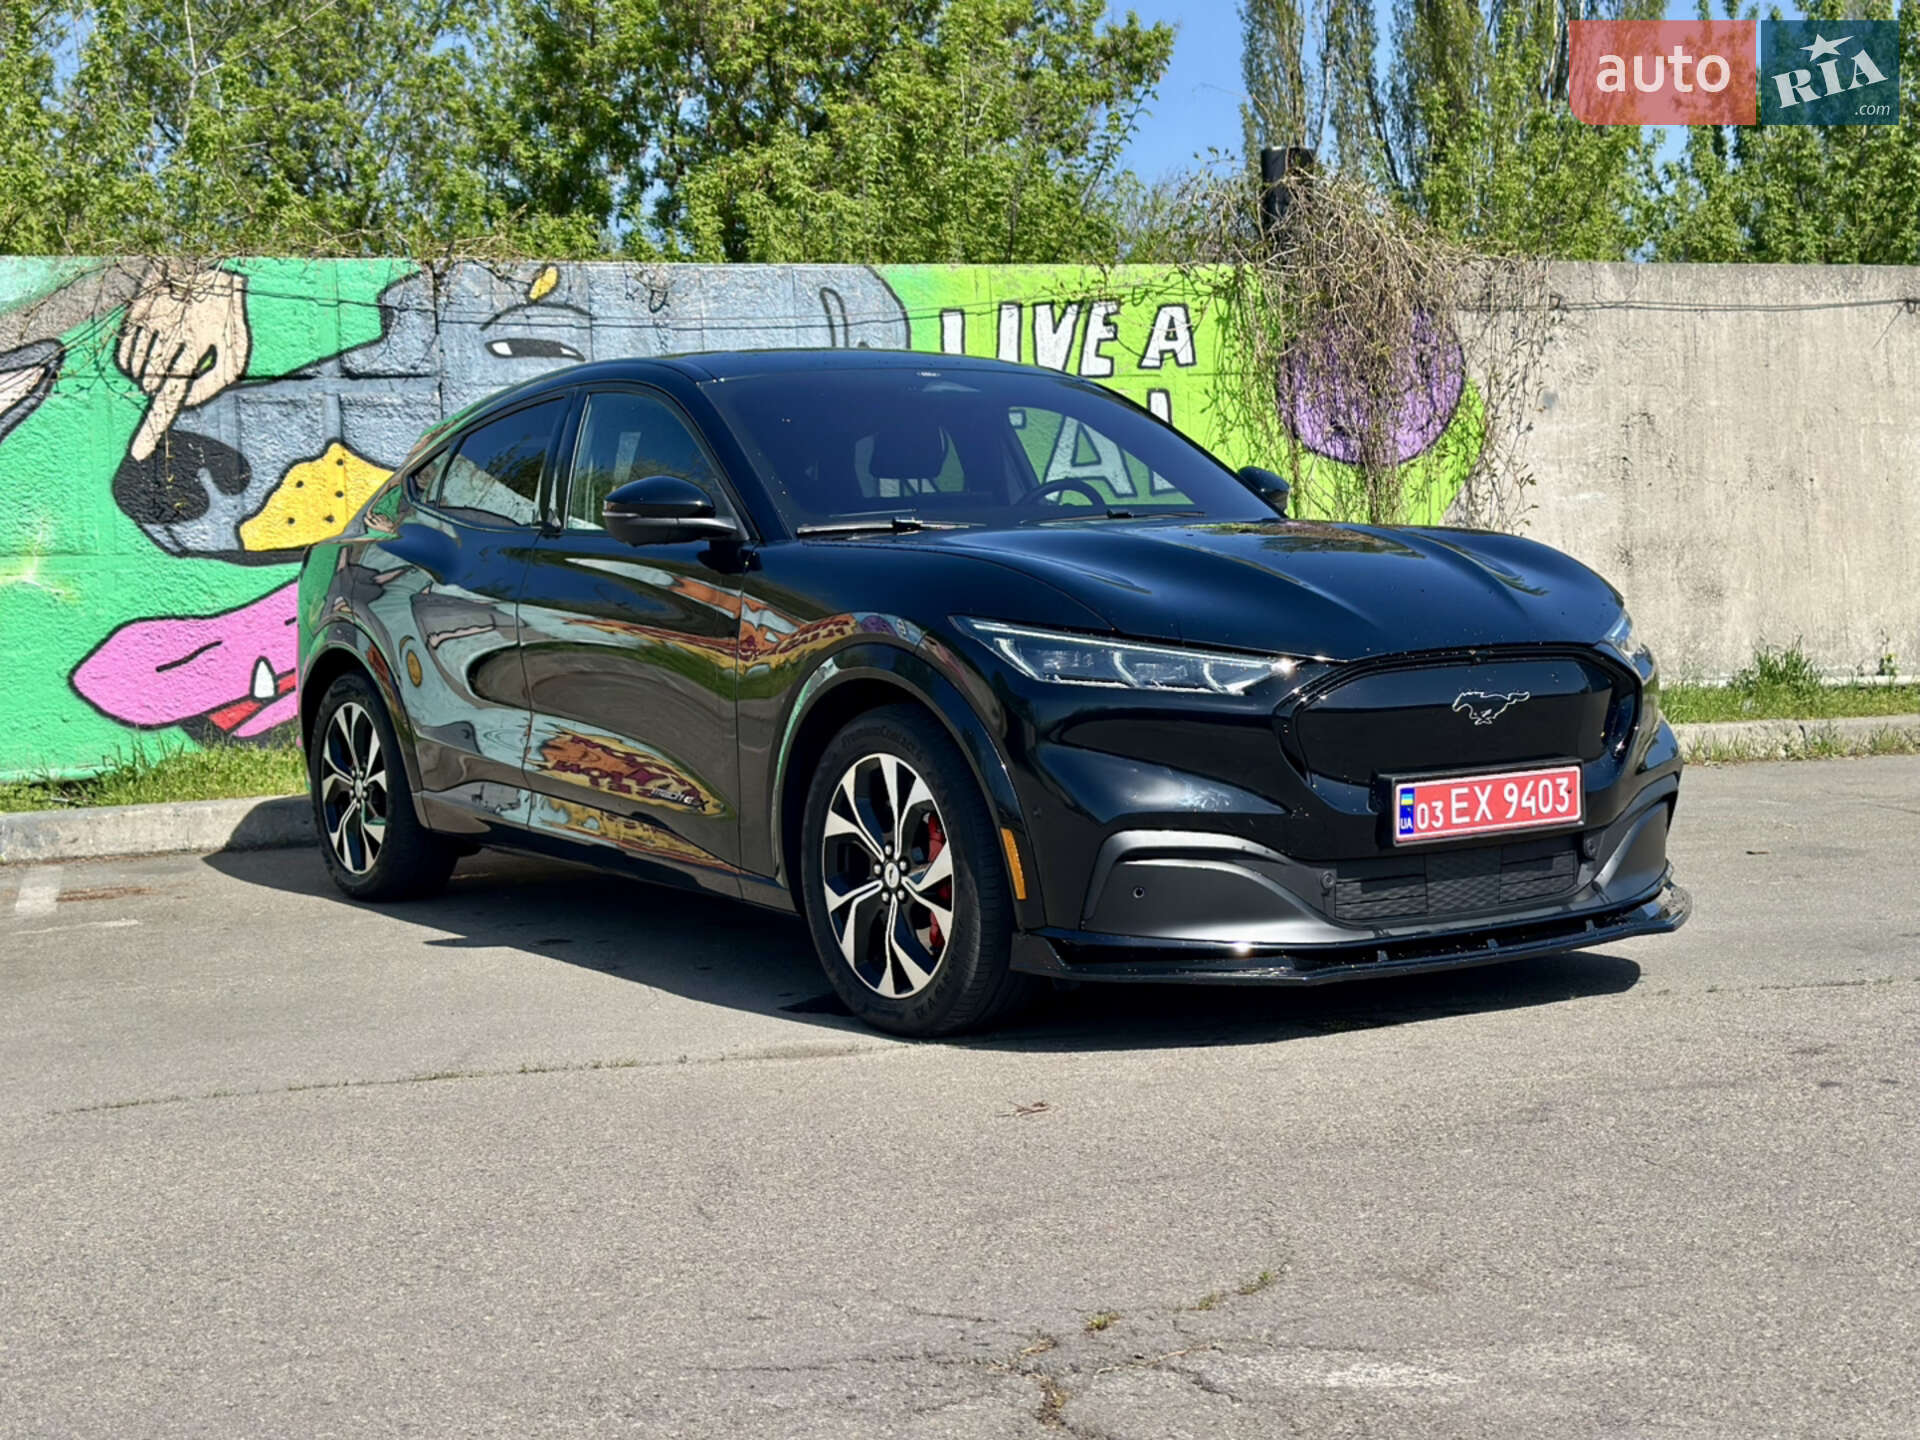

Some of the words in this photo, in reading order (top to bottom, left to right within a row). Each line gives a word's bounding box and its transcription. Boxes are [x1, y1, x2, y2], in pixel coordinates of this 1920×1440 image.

[1138, 303, 1196, 369] A
[1400, 817, 1413, 829] UA
[1416, 800, 1444, 830] 03
[1451, 784, 1494, 825] EX
[1503, 777, 1570, 819] 9403
